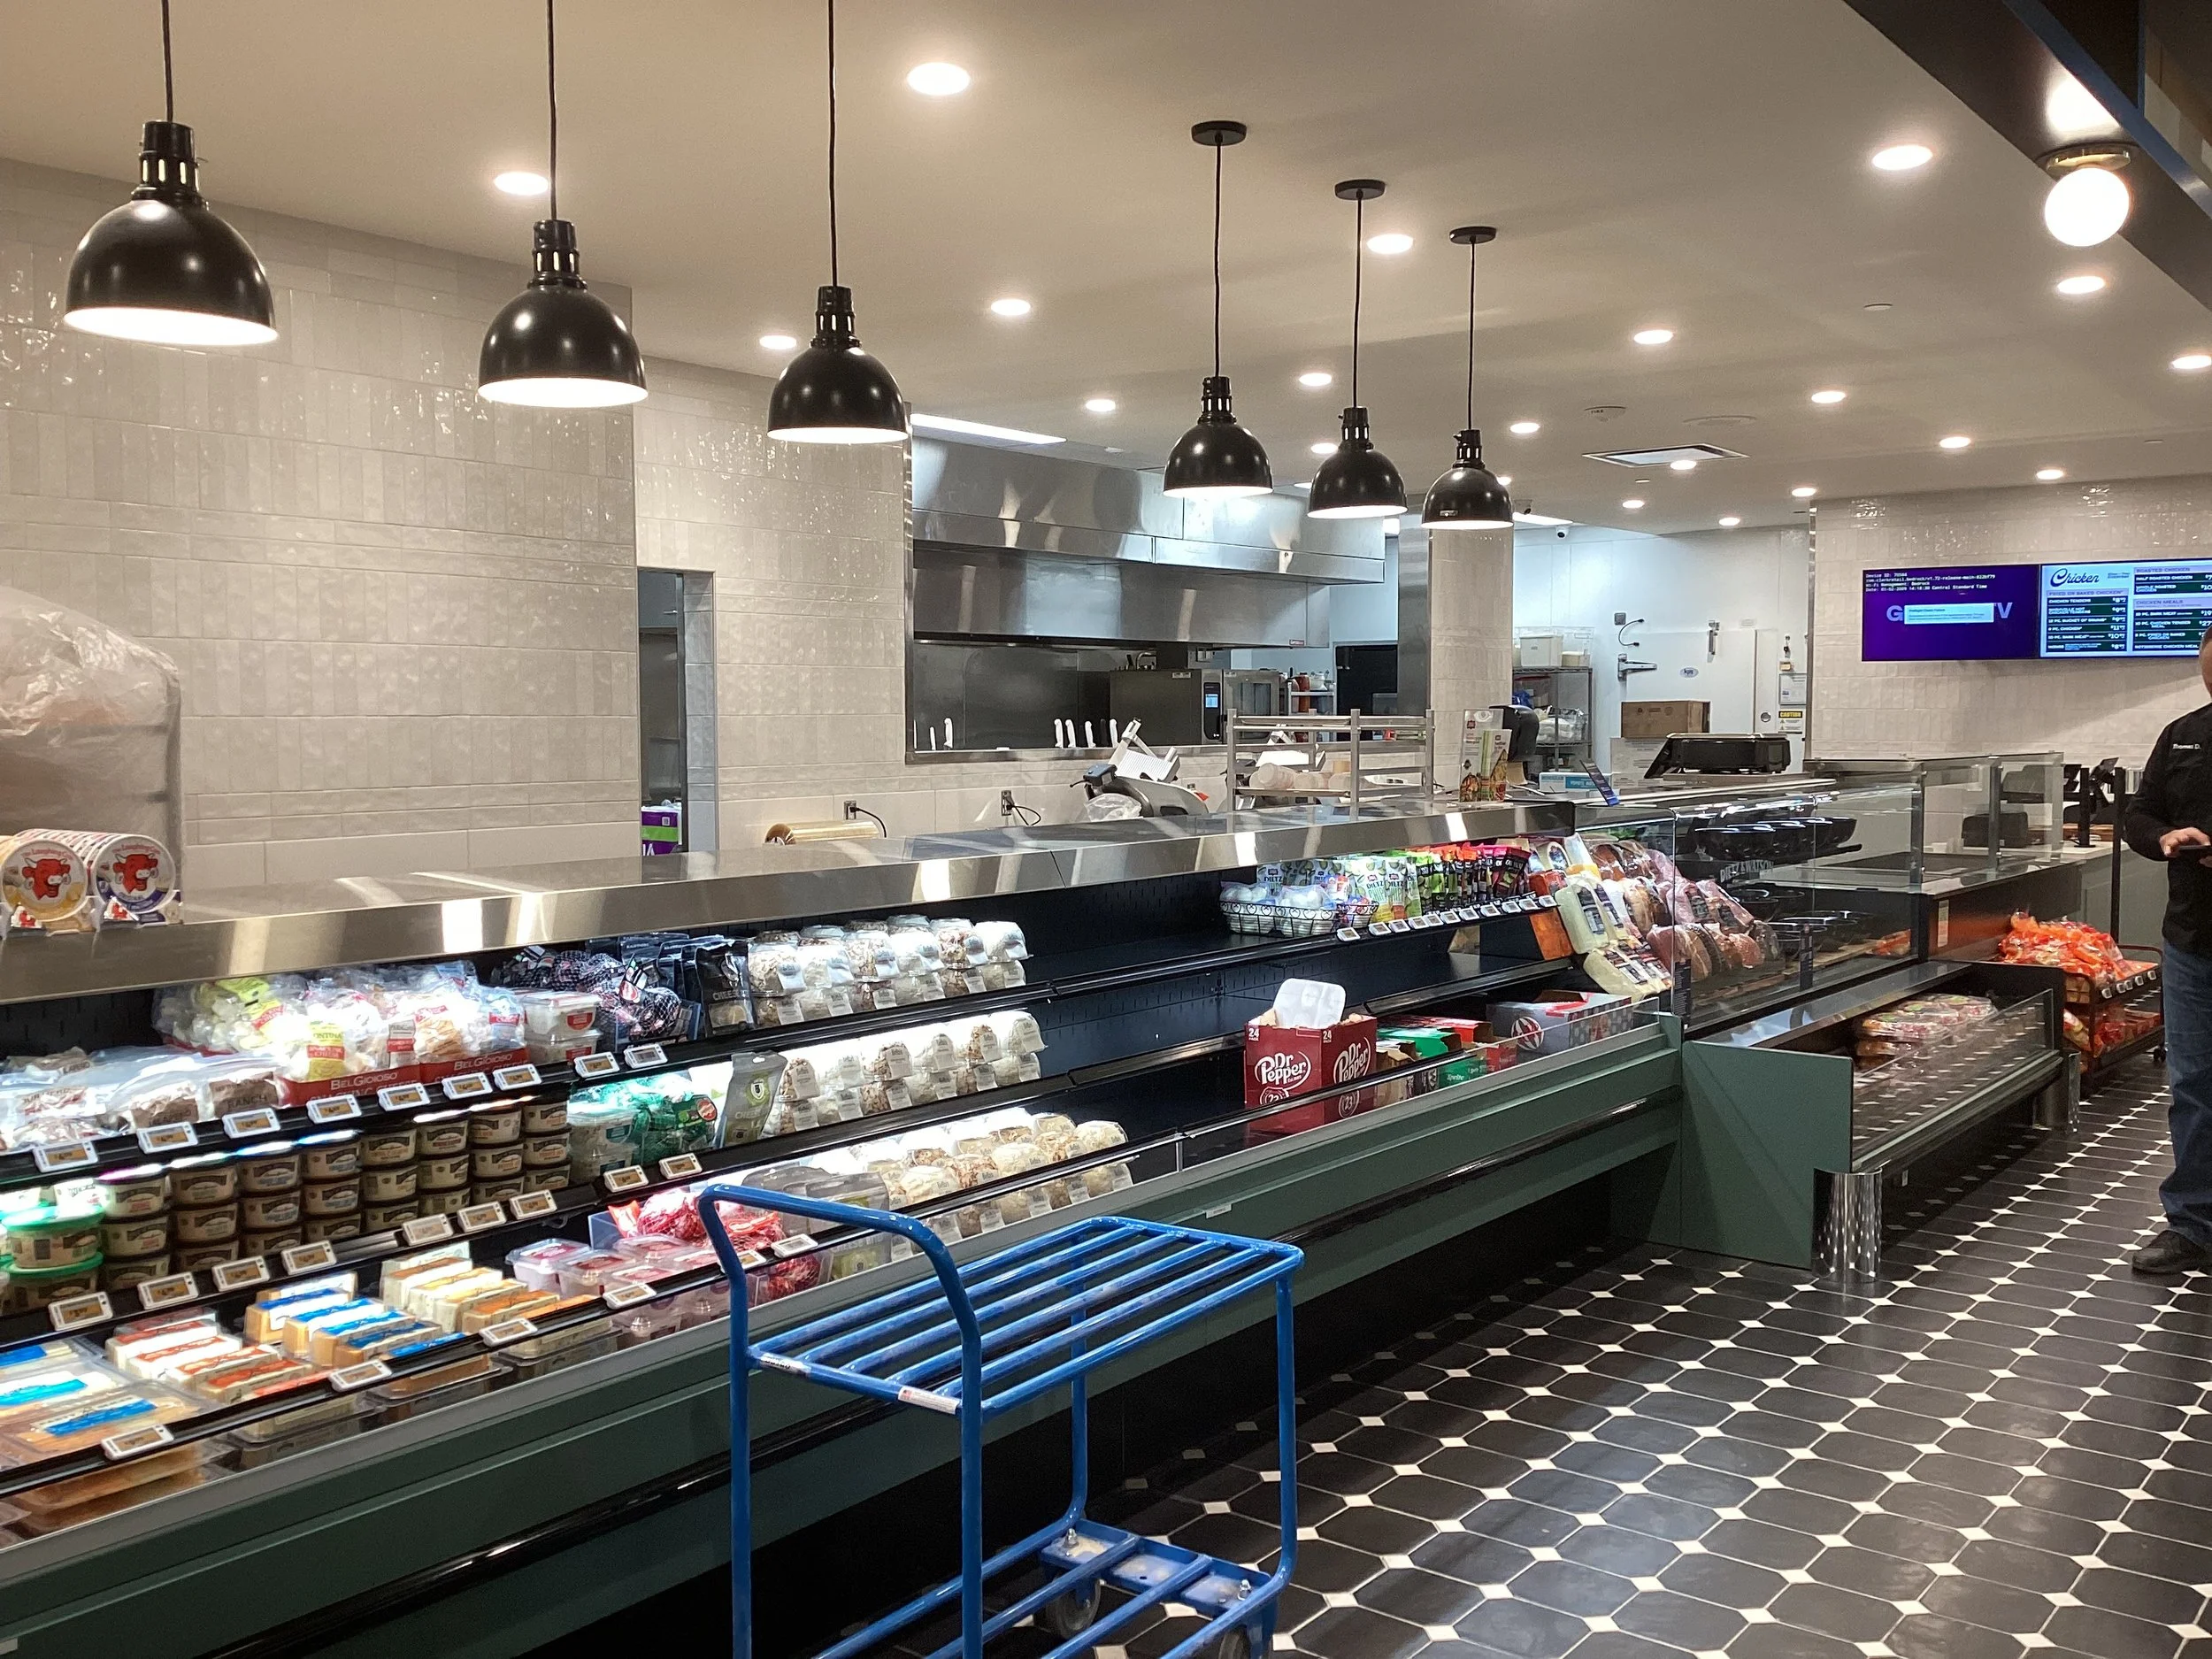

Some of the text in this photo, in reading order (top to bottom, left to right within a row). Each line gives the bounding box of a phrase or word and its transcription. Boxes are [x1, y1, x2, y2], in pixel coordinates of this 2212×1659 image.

[2050, 568, 2100, 588] Chicken
[1248, 1028, 1259, 1038] 24
[1323, 1030, 1333, 1040] 24
[1349, 1043, 1362, 1059] Dr
[1275, 1053, 1294, 1068] Dr
[1335, 1049, 1369, 1082] Pepper
[1257, 1056, 1307, 1086] Pepper
[1344, 1095, 1353, 1110] 23
